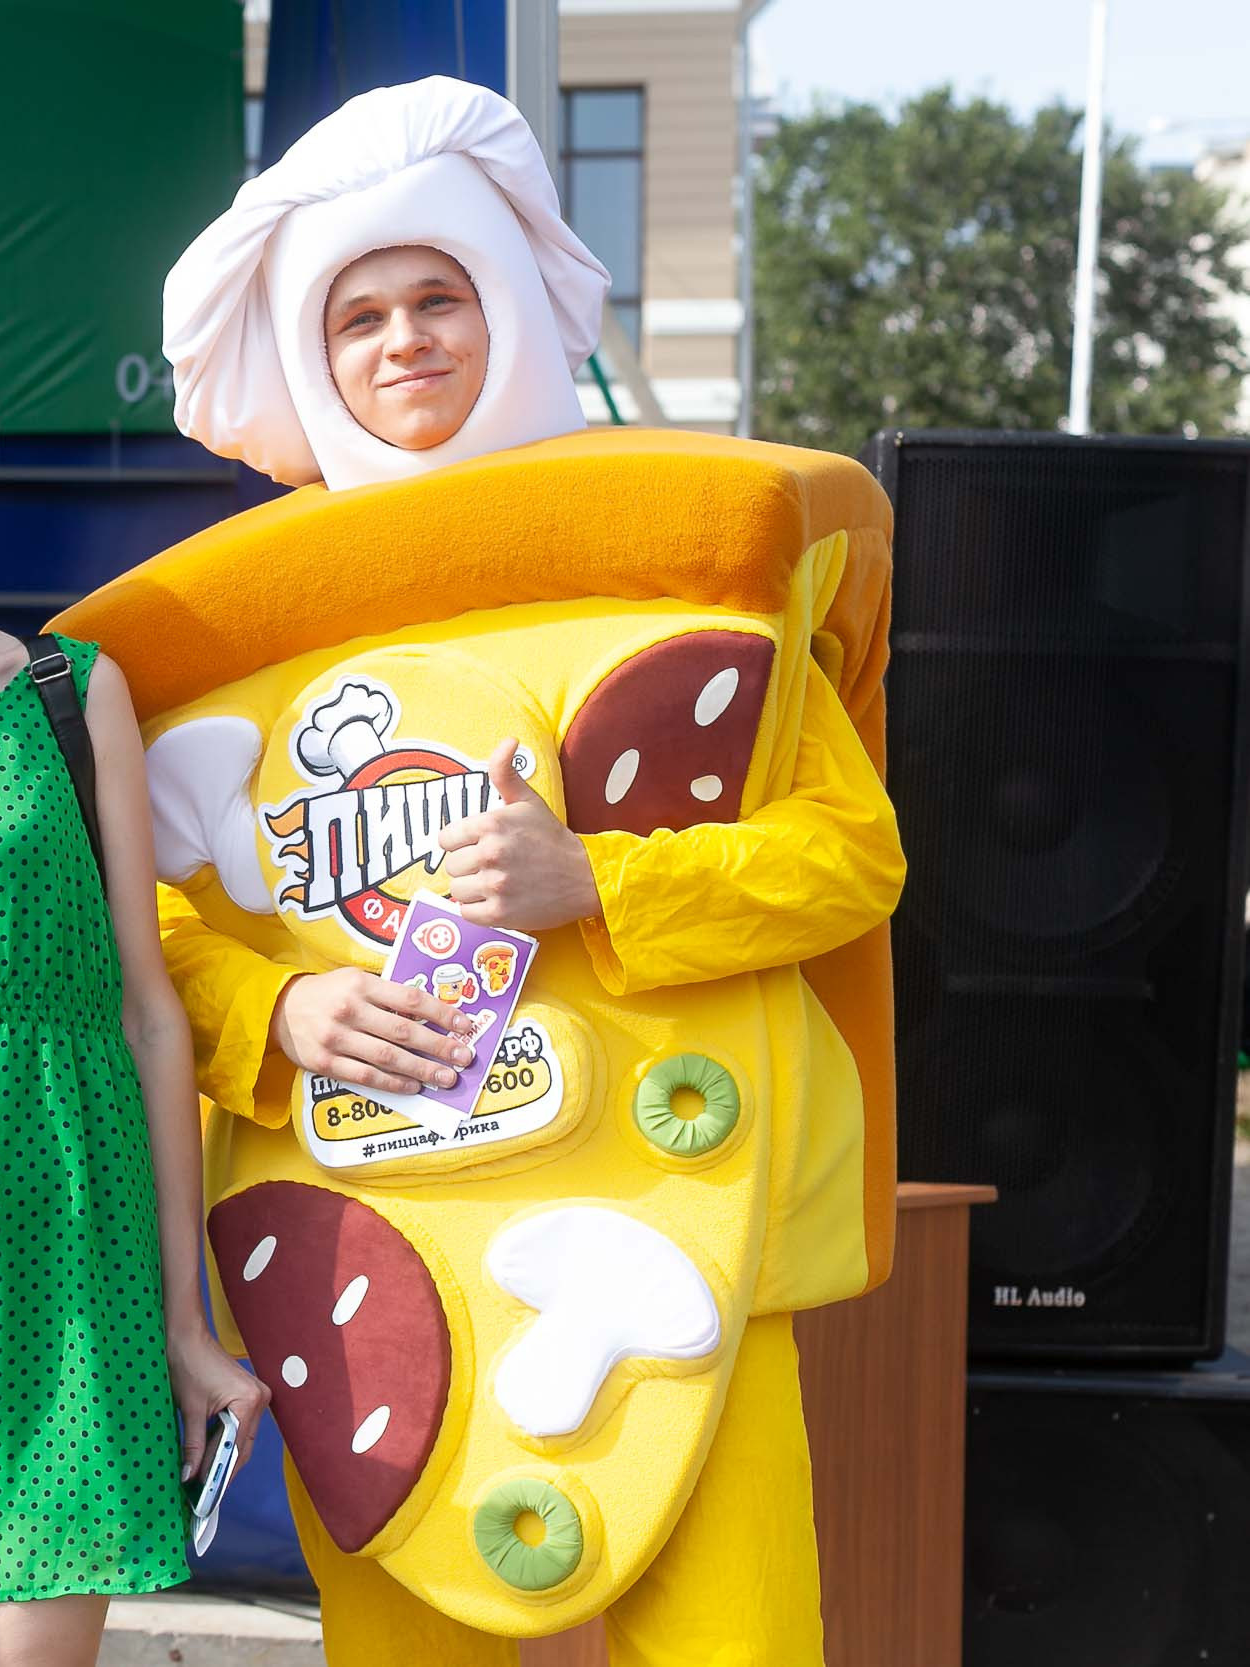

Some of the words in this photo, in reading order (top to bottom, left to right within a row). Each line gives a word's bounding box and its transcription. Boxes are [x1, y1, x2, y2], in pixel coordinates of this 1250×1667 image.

[306, 771, 502, 911] ПИЦ
[361, 1120, 501, 1158] #пиццафрика
[994, 1286, 1023, 1306] HL
[1026, 1285, 1087, 1308] Audio
